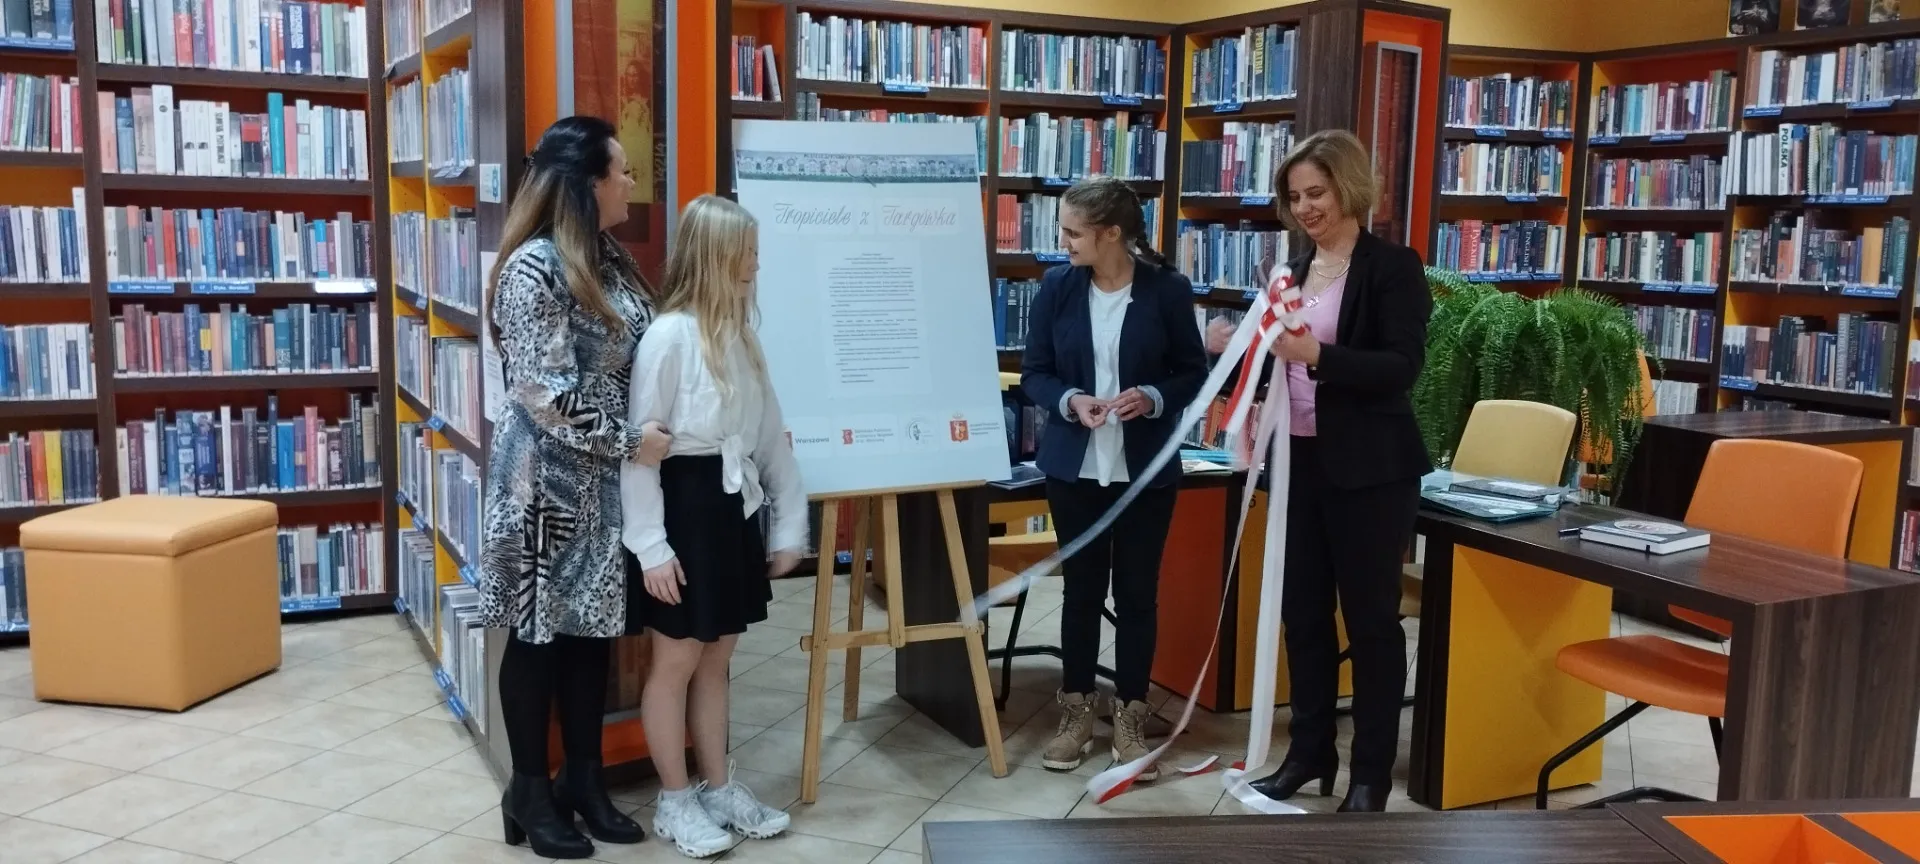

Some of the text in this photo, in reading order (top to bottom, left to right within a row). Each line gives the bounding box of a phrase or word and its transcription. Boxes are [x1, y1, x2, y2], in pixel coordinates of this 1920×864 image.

[773, 202, 957, 233] Tropiciele z Targówka
[1523, 231, 1532, 266] ENGLISH
